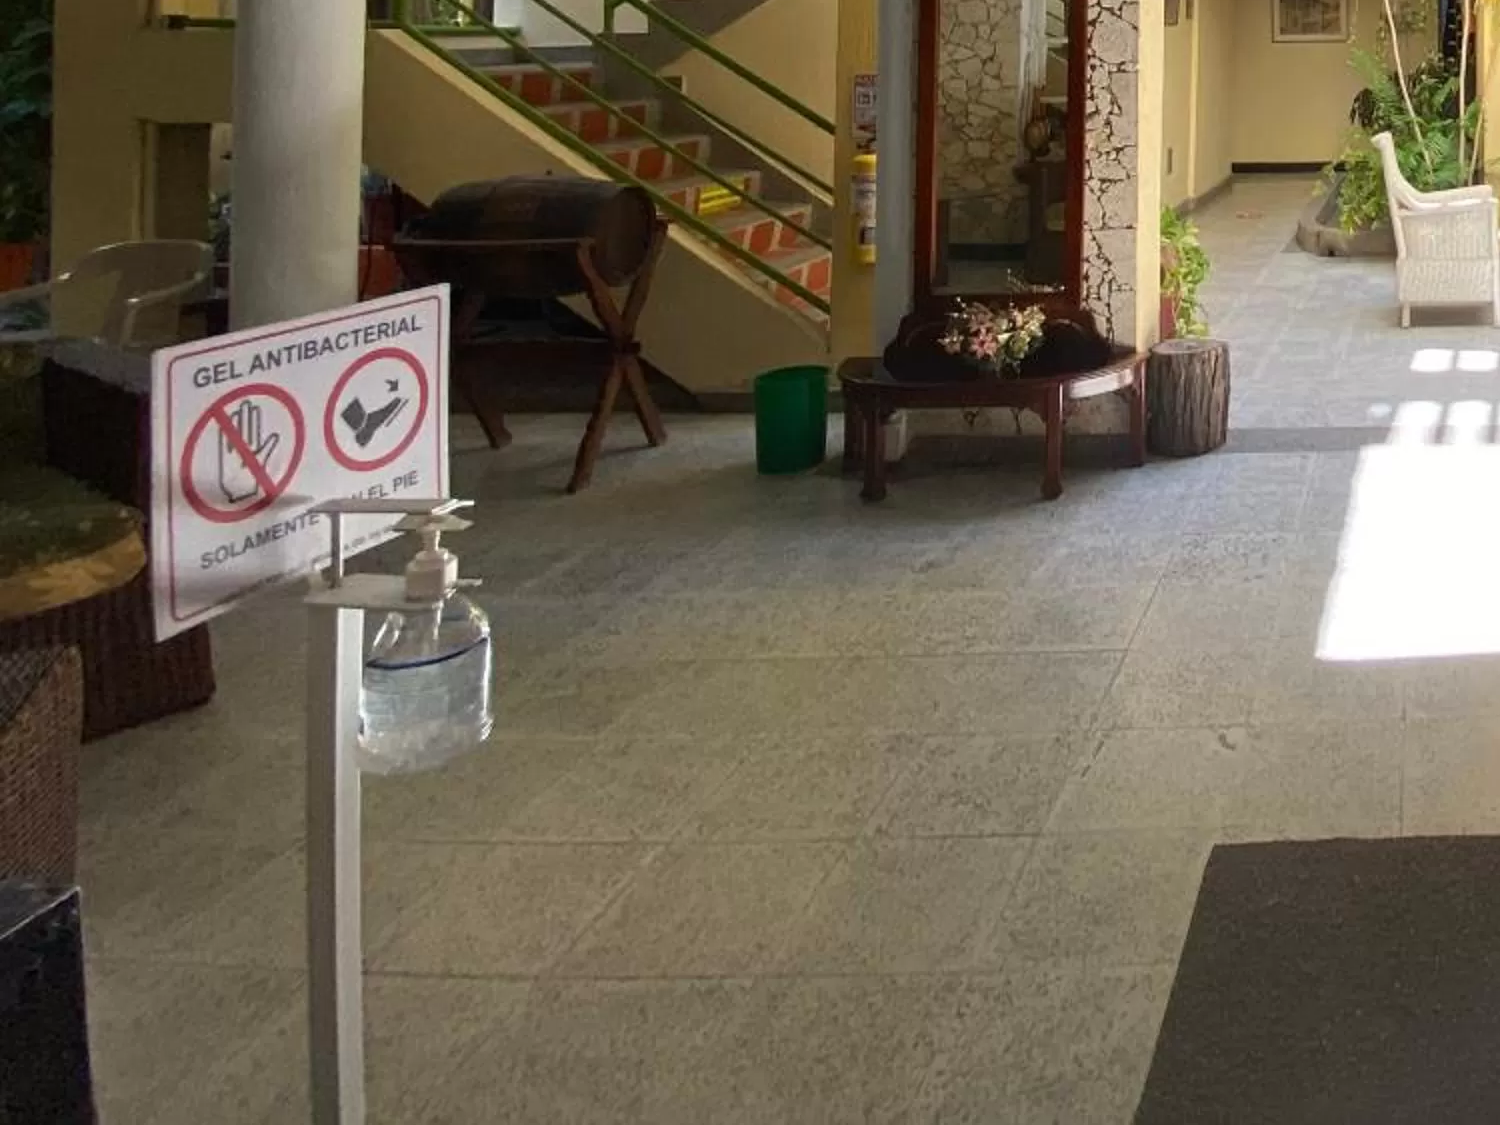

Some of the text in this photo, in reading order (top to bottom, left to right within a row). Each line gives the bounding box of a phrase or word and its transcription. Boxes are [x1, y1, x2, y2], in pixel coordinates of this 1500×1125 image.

[193, 314, 422, 389] GEL ANTIBACTERIAL
[392, 470, 420, 492] PIE
